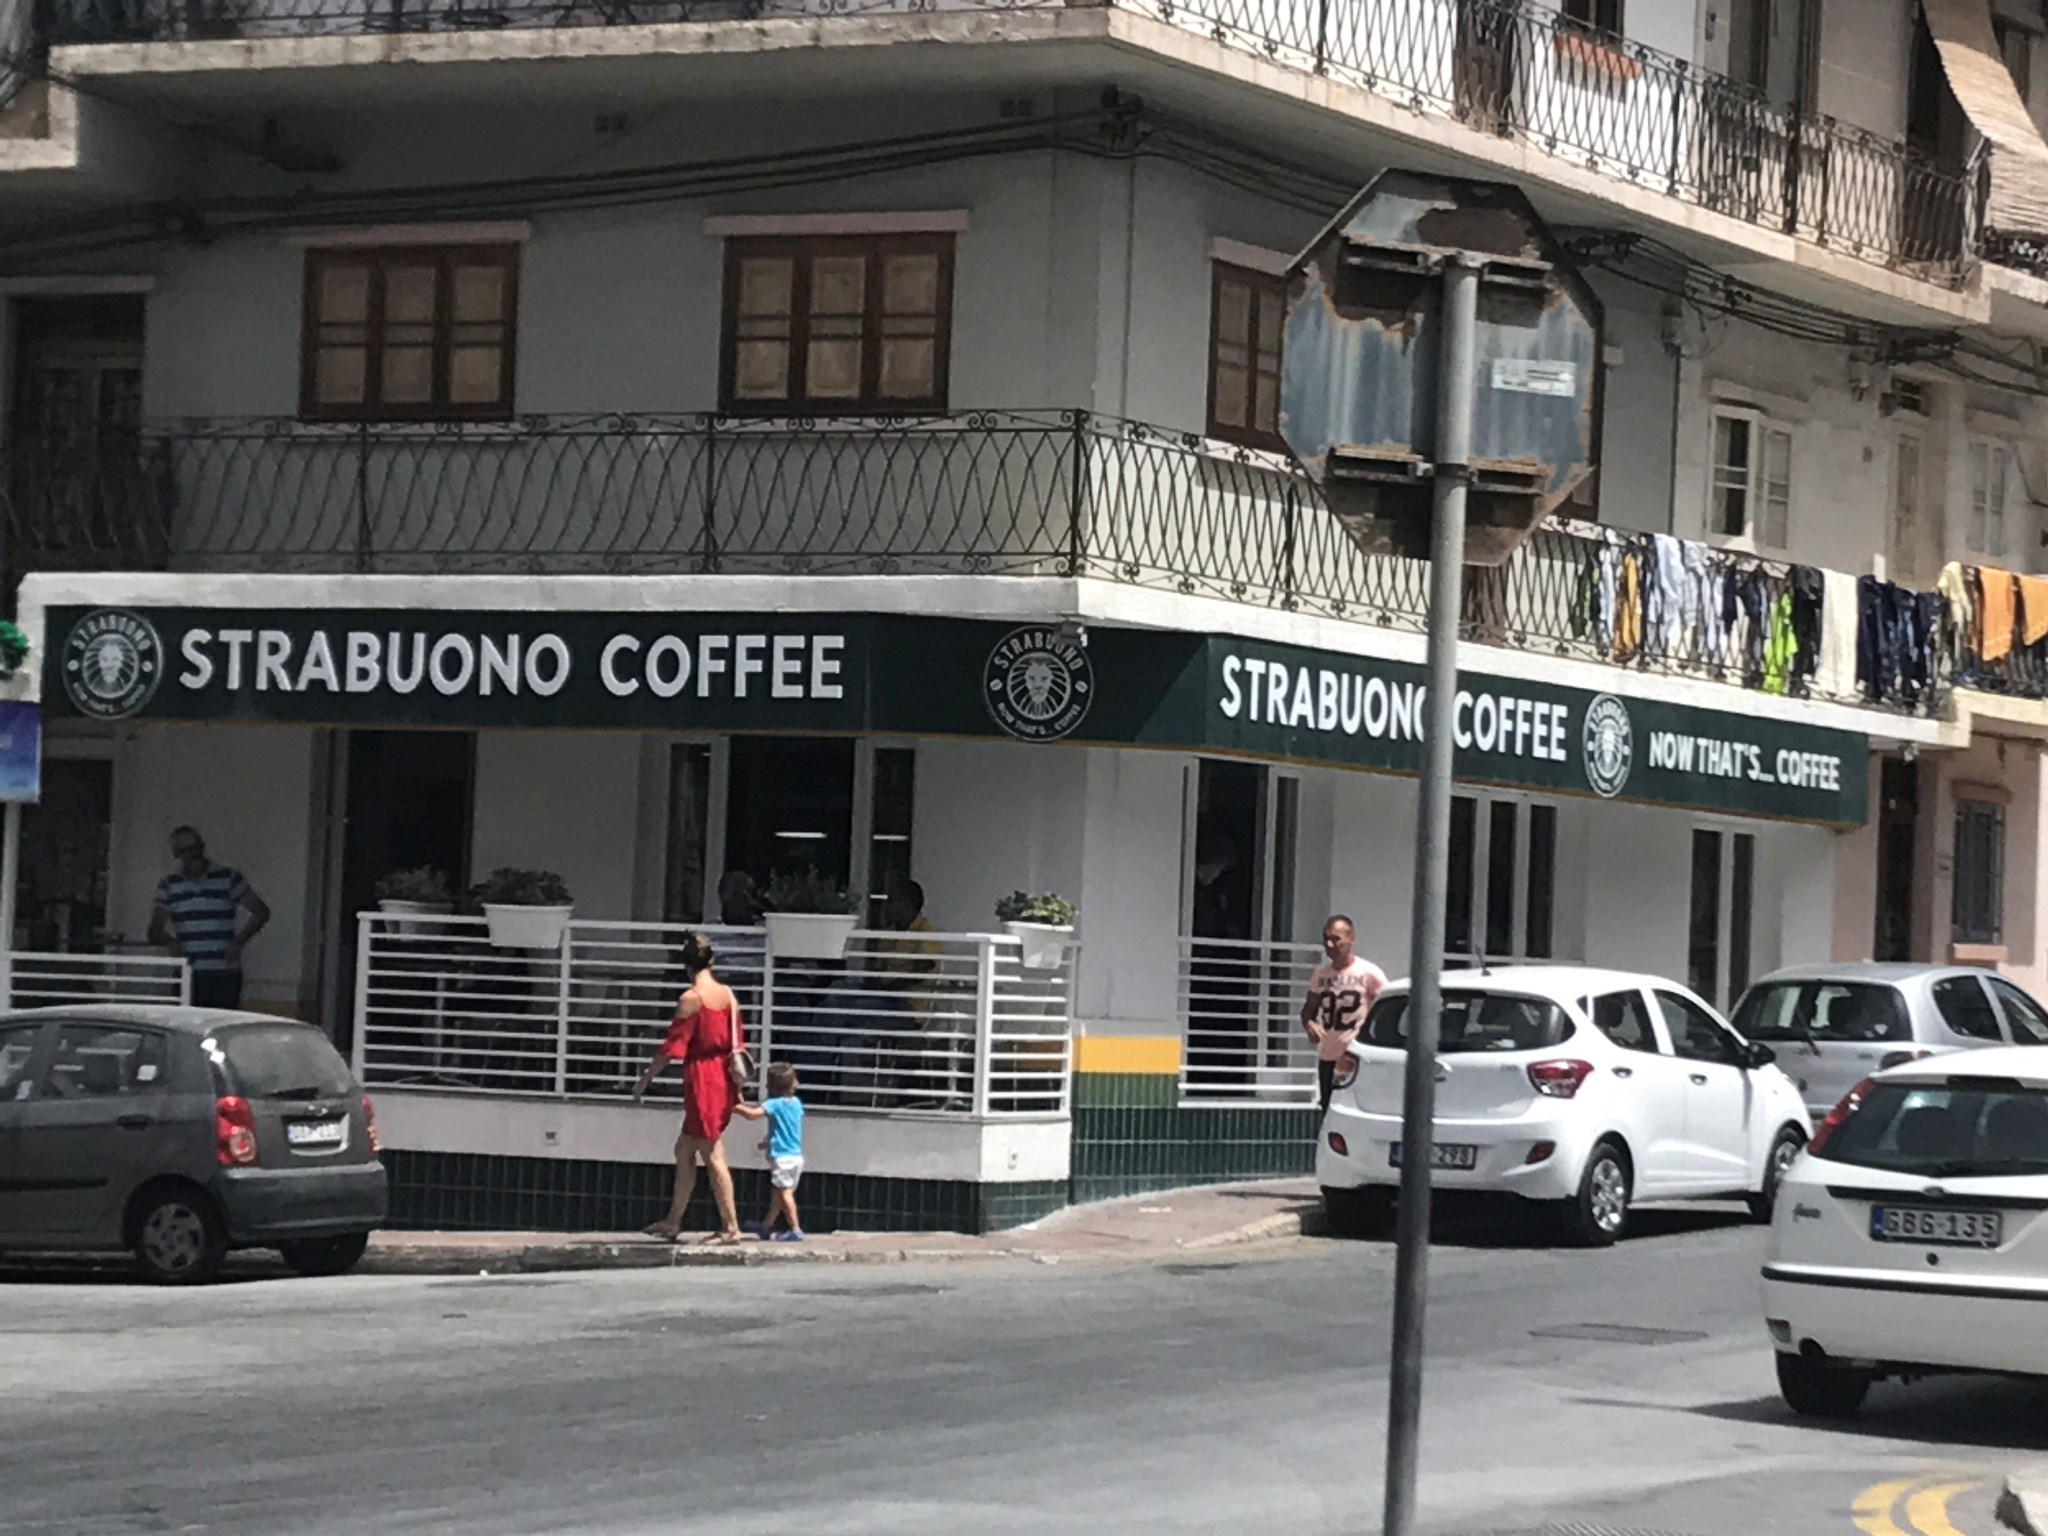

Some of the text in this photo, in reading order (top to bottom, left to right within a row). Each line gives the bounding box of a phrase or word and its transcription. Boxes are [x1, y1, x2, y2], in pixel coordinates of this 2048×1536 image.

[179, 628, 845, 699] STRABUONO COFFEE
[1452, 689, 1568, 762] COFFEE
[1648, 731, 1694, 772] NOW
[1776, 748, 1841, 791] COFFEE
